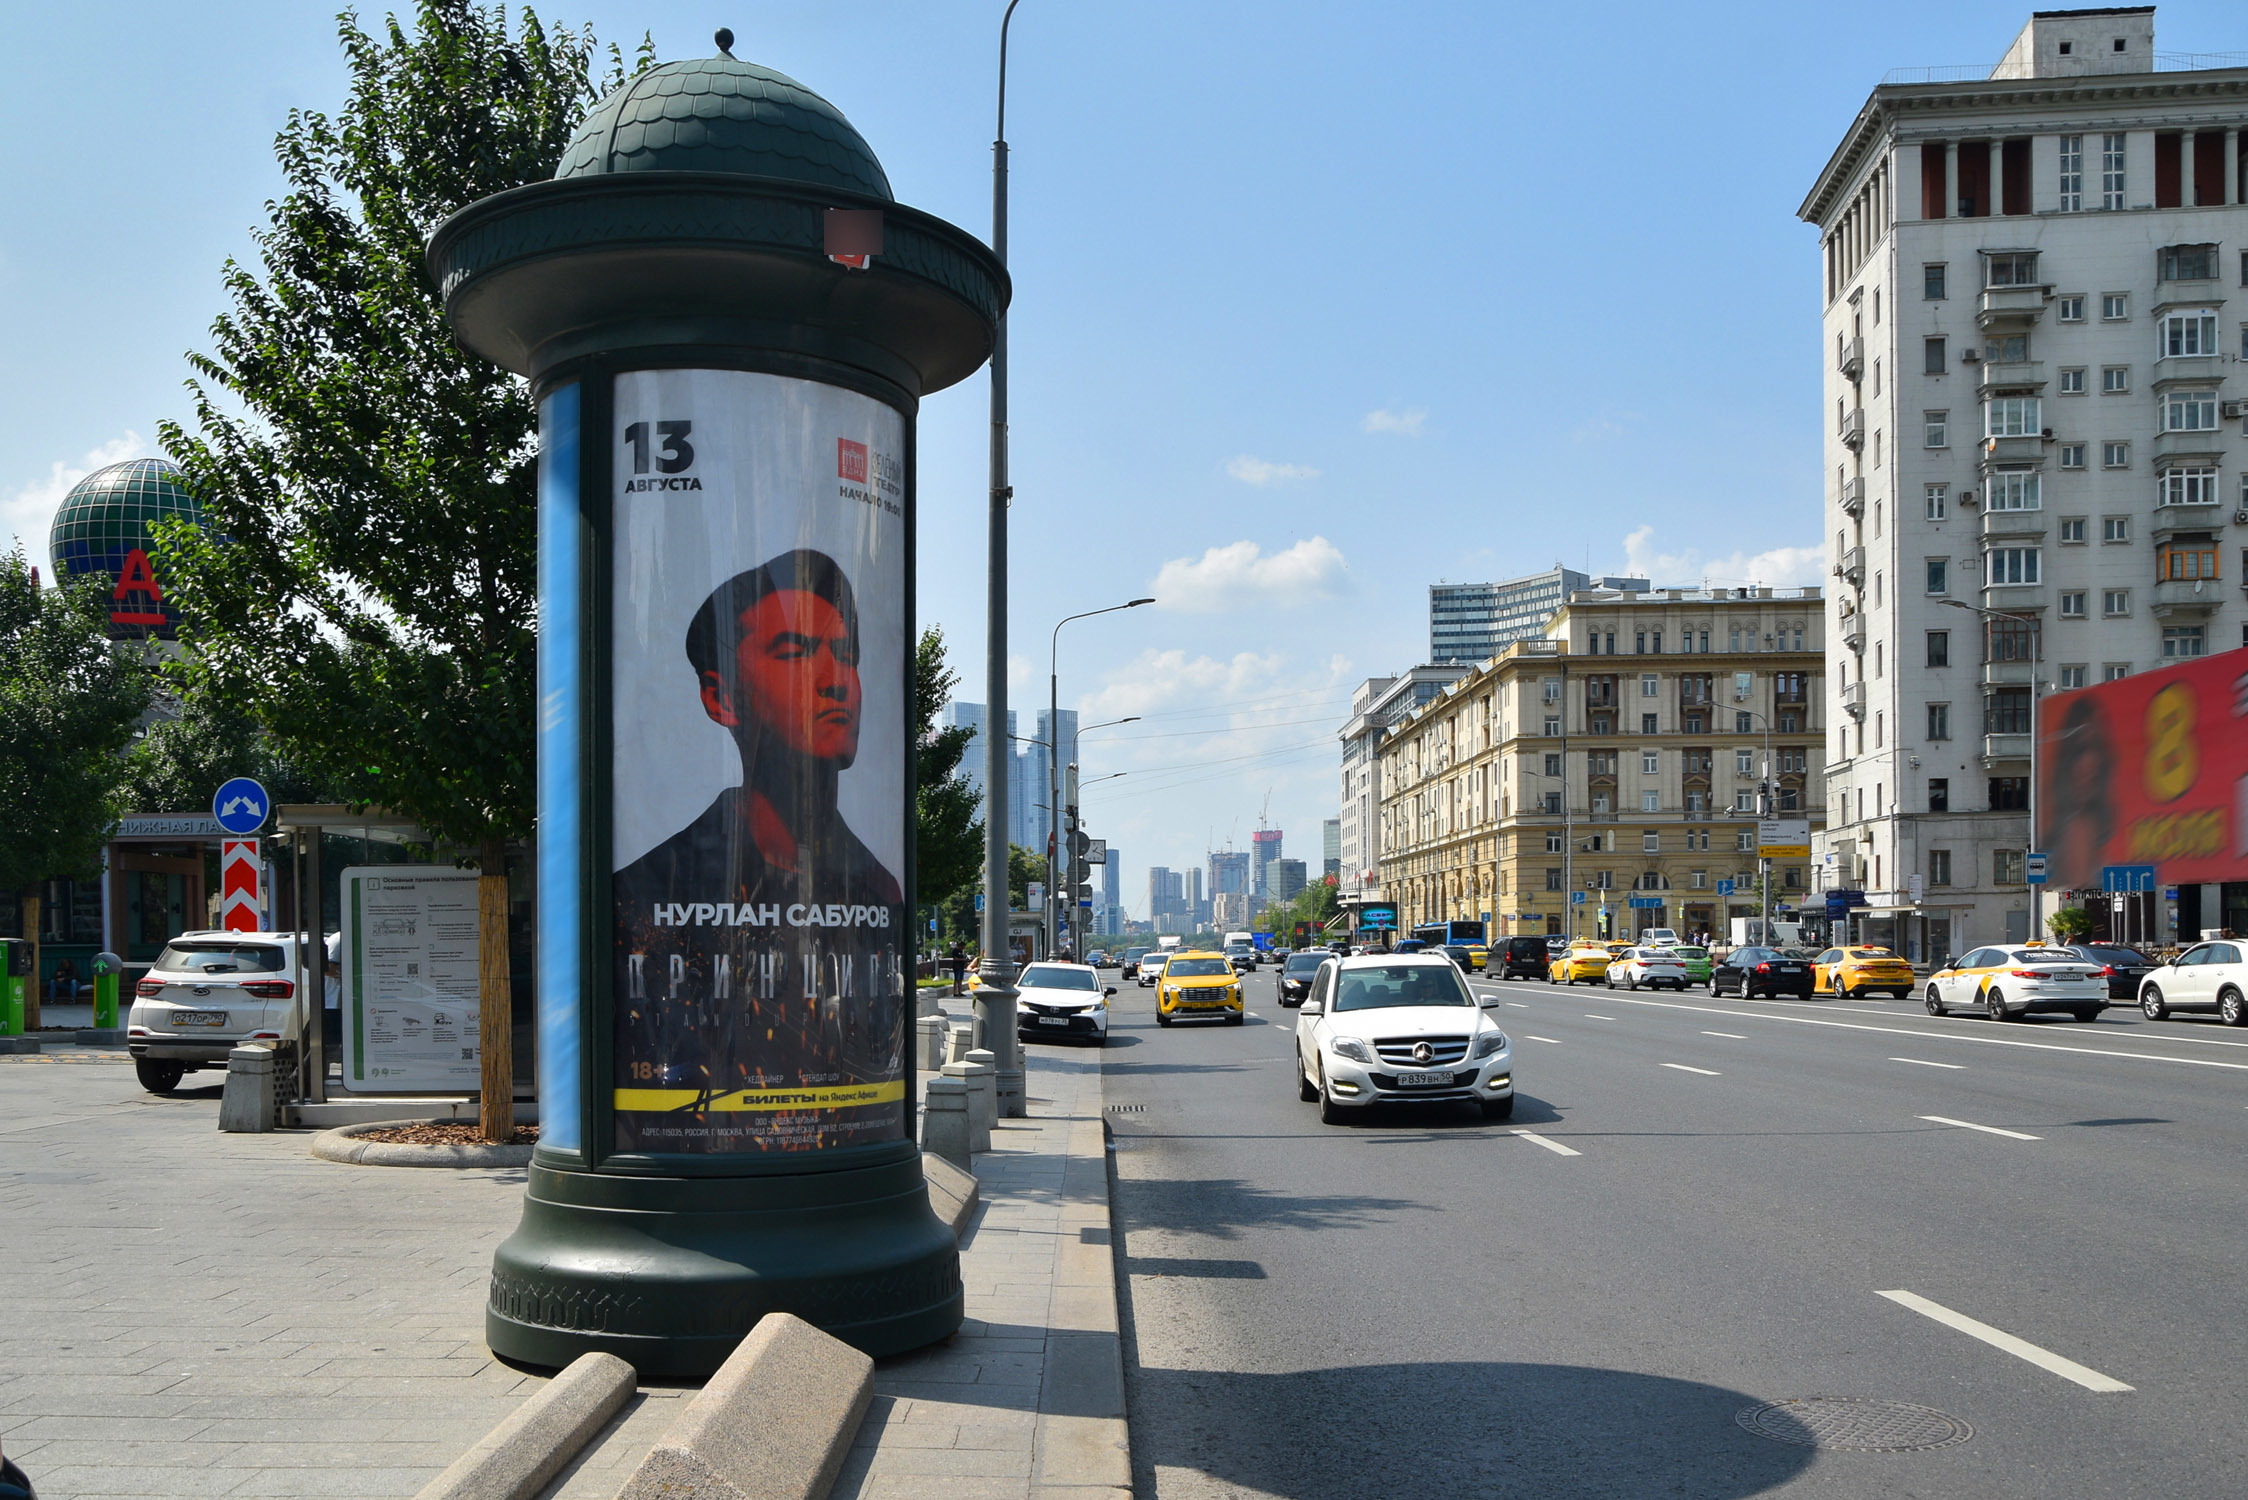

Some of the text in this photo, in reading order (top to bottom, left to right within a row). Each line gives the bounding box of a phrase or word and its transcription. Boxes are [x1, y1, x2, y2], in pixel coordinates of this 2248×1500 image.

[624, 420, 695, 475] 13
[842, 466, 865, 480] ВДНХ
[625, 477, 703, 494] АВГУСТА
[873, 475, 900, 497] ТЕАТР
[839, 485, 882, 508] НАЧАЛО
[197, 820, 230, 833] ЛА
[654, 903, 890, 928] НУРЛАН САБУРОВ
[630, 1061, 668, 1080] 18+
[828, 1072, 840, 1082] ШОУ
[1401, 1073, 1439, 1084] Р839ВН
[743, 1093, 816, 1105] БИЛЕТЫ
[831, 1093, 857, 1103] Яндекс
[755, 1117, 767, 1125] ООО
[745, 1127, 766, 1136] УЛИЦА
